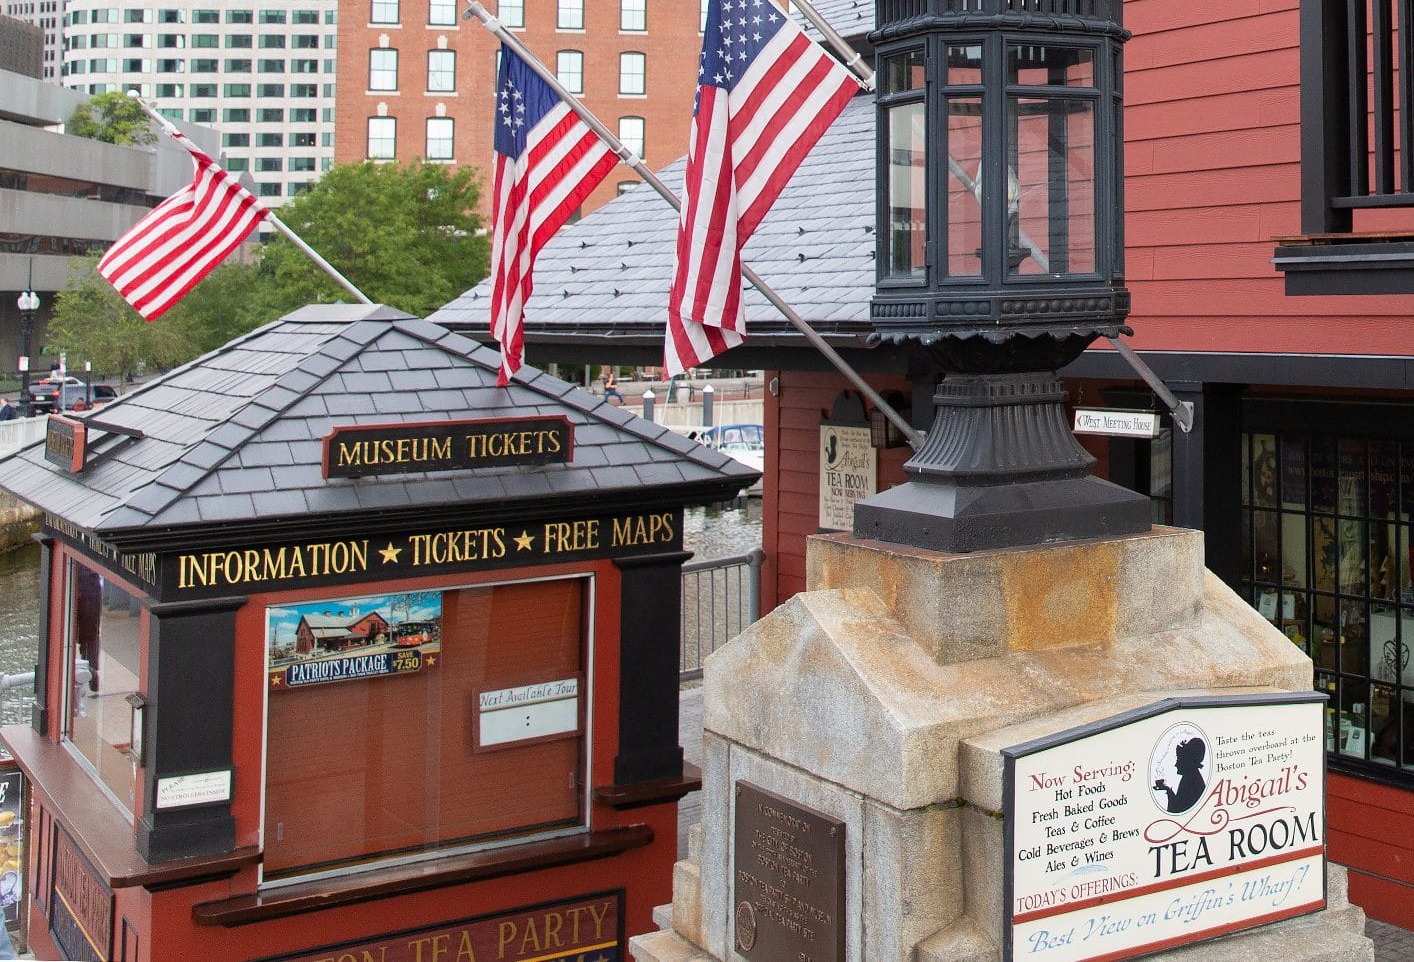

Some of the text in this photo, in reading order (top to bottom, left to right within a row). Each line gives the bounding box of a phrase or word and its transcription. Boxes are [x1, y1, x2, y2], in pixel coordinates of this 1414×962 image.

[1082, 415, 1152, 431] WEST MEETING HOUSE
[338, 430, 562, 467] MUSEUM TICKETS
[826, 472, 869, 490] TEA ROOM
[178, 513, 675, 589] INFORMATION TICKETS FREE MAPS
[291, 656, 342, 682] PATRIOTS
[343, 654, 387, 675] PACKAGE
[392, 656, 419, 670] $7.50
[480, 682, 576, 707] Next Available Tour
[1215, 729, 1275, 746] Taste the teas
[1216, 733, 1316, 759] thrown overboard at the
[1216, 749, 1294, 773] Boston Tea Party!
[1028, 760, 1136, 792] Now Serving:
[1207, 765, 1309, 808] Abigail's
[1055, 782, 1106, 802] Hot Foods
[1032, 794, 1128, 824] Fresh Baked Goods
[1045, 815, 1116, 839] Teas & Coffee
[1018, 827, 1140, 861] Cold Beverages & Brews
[1148, 811, 1319, 878] TEA ROOM
[1045, 849, 1114, 874] Ales & Wines
[1016, 872, 1140, 913] TODAY'S OFFERINGS:
[1027, 865, 1312, 954] Best View on Griffin's Wharf!
[497, 901, 613, 961] PARTY
